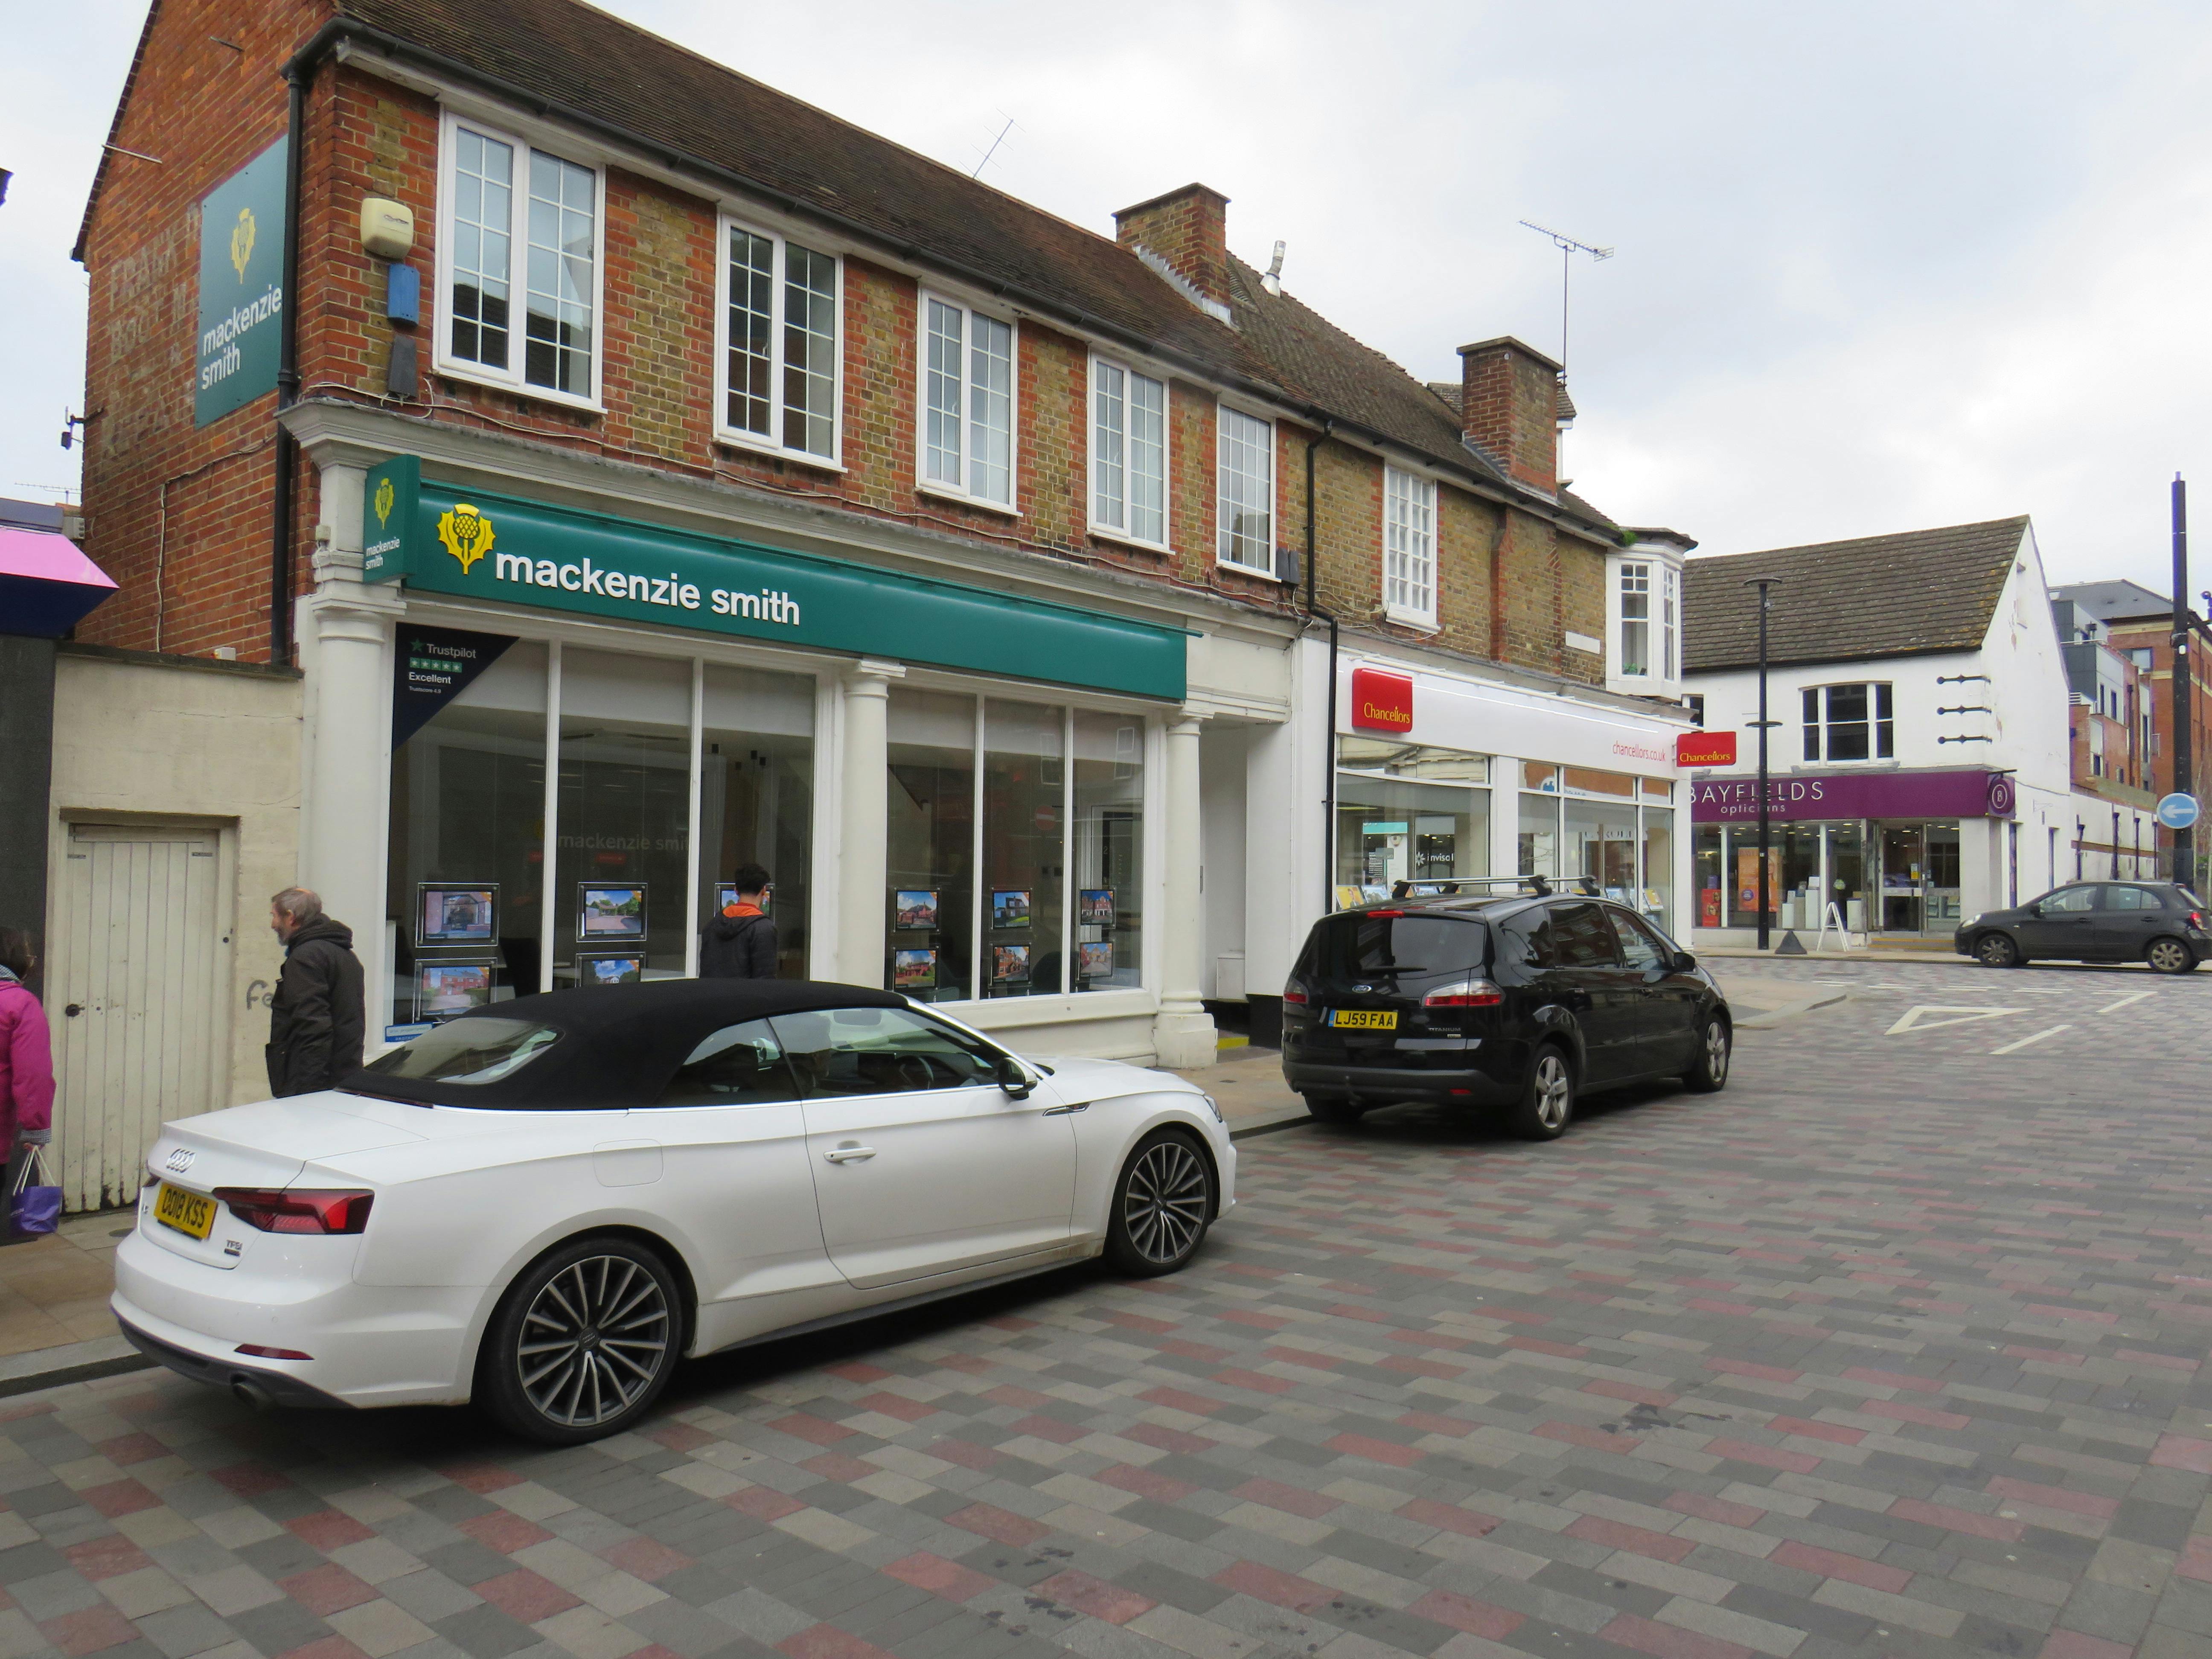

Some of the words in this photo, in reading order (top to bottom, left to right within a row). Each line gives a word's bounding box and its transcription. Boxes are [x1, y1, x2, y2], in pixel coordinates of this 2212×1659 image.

[204, 284, 282, 356] mackenzie
[202, 342, 240, 390] smith
[366, 536, 400, 556] mackenzie
[366, 554, 383, 570] smith
[496, 552, 700, 610] mackenzie
[711, 588, 800, 625] smith
[427, 643, 476, 658] Trustpilot
[408, 672, 451, 684] Excellent
[1364, 702, 1410, 724] Chancellors
[1612, 740, 1666, 762] chancellors.co.uk
[1679, 751, 1730, 762] Chancellors
[1720, 803, 1785, 816] opticins
[558, 832, 650, 850] mackenzie
[1336, 1012, 1367, 1025] LJ59
[1370, 1013, 1393, 1027] FAA
[183, 1196, 208, 1228] KSS
